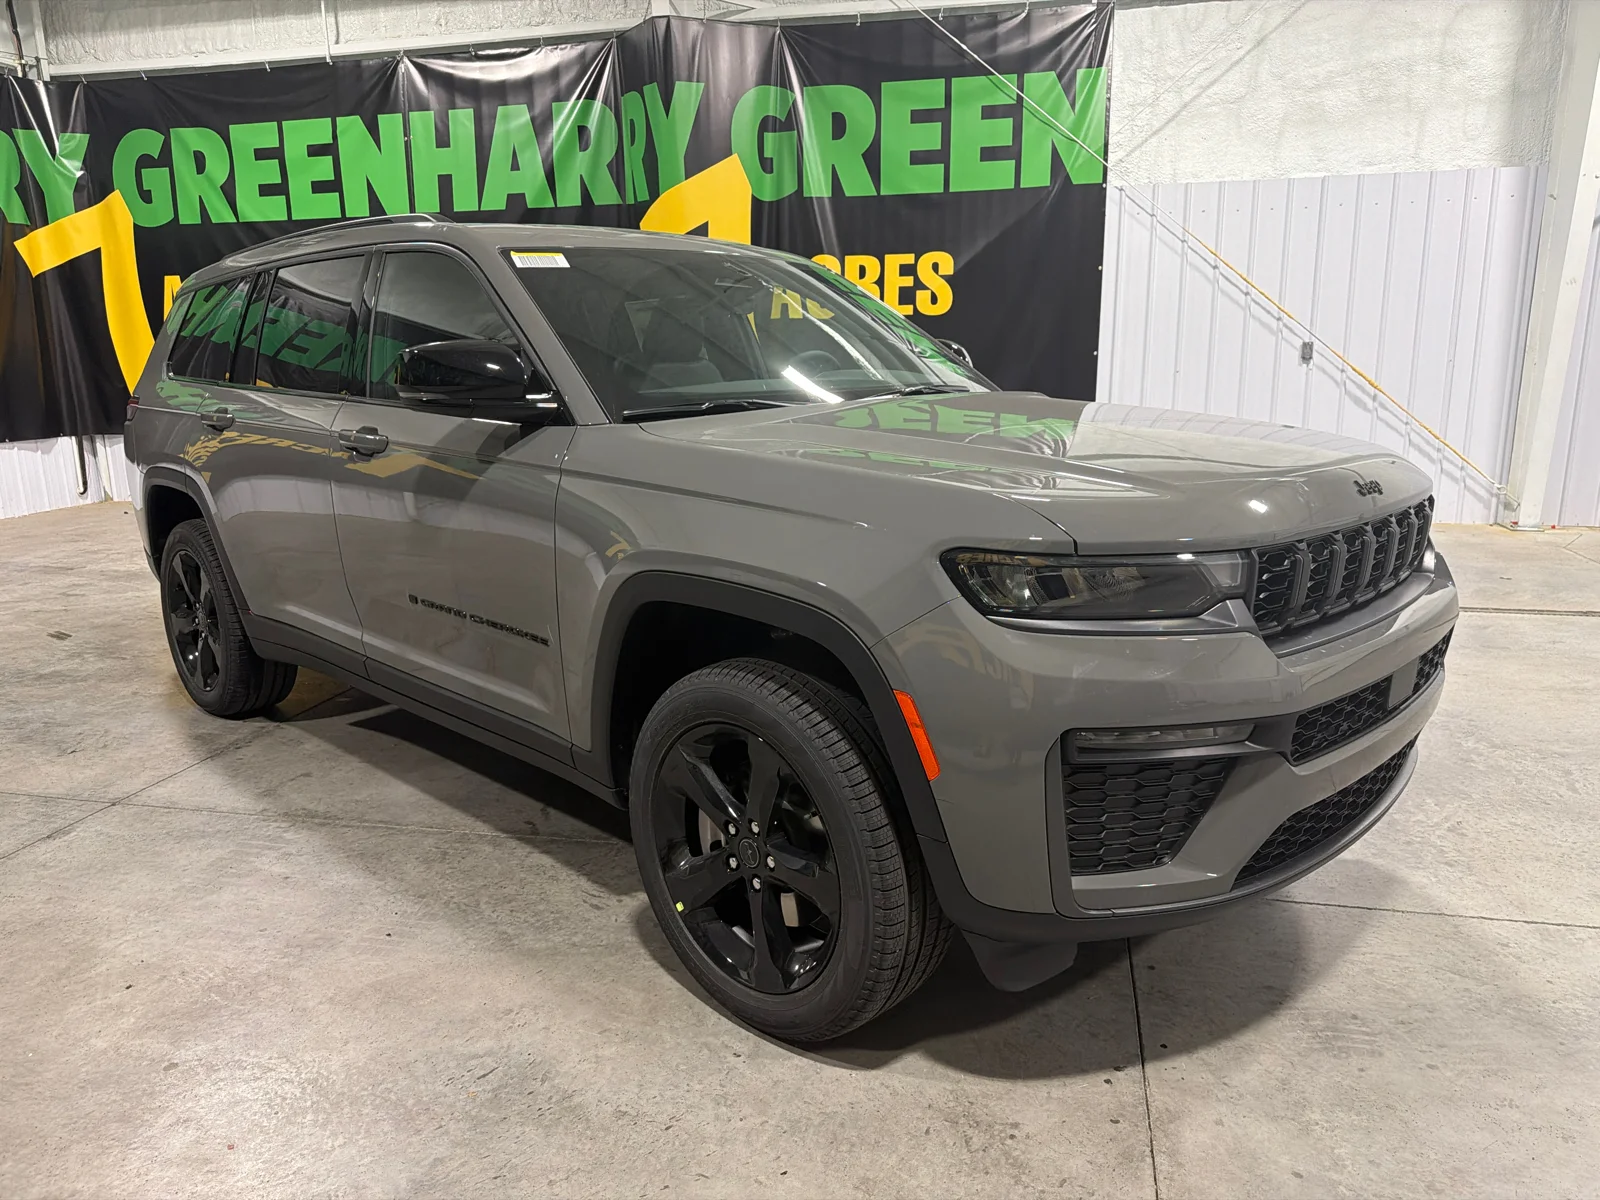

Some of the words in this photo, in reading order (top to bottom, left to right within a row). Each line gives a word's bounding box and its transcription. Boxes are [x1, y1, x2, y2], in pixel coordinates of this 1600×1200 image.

[112, 112, 411, 227] GREEN
[408, 82, 704, 214] HARRY
[730, 67, 1107, 201] GREEN
